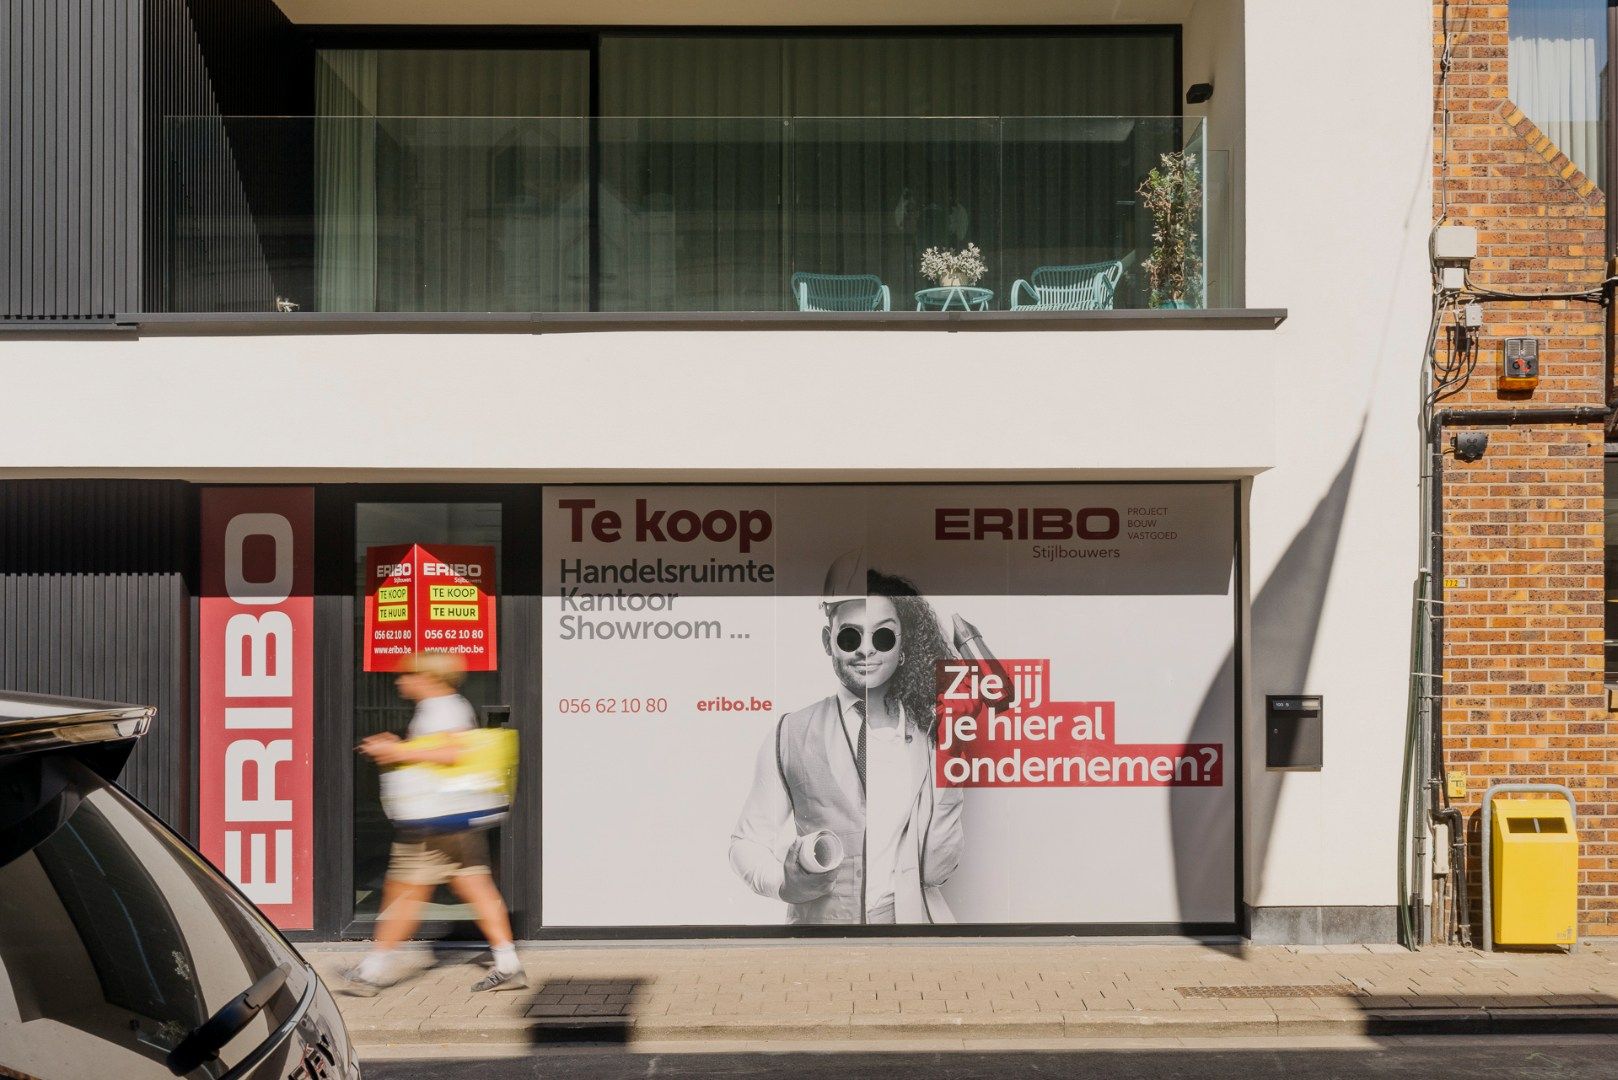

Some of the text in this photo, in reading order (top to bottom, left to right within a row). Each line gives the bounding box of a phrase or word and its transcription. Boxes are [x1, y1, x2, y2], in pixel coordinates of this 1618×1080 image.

[1127, 507, 1168, 516] PROJECT
[559, 499, 772, 553] Te koop
[935, 507, 1120, 541] ERIBO
[1127, 520, 1157, 528] BOUW
[1127, 532, 1178, 540] VASTGOED
[1032, 546, 1120, 561] Stijlbouwers
[376, 563, 412, 578] ERIBO
[424, 563, 481, 576] ERIBO
[560, 558, 775, 584] Handelsruimte
[380, 588, 406, 599] TE KOOP
[433, 588, 475, 597] TE KOOP
[561, 587, 679, 612] Kantoor
[380, 608, 406, 618] TE HUUR
[433, 608, 476, 616] TE HUUR
[374, 630, 412, 639] 056 62 10 80
[425, 630, 484, 639] 056 62 10 80
[559, 615, 722, 640] Showroom
[374, 645, 412, 654] www.eribo.be
[424, 645, 484, 654] www.eribo.be
[944, 666, 1042, 708] Zie jij
[225, 513, 293, 905] ERIBO
[559, 698, 668, 713] 056 62 10 80
[697, 697, 772, 711] eribo.be
[940, 707, 1105, 750] je hier al
[944, 748, 1218, 783] ondernemen?
